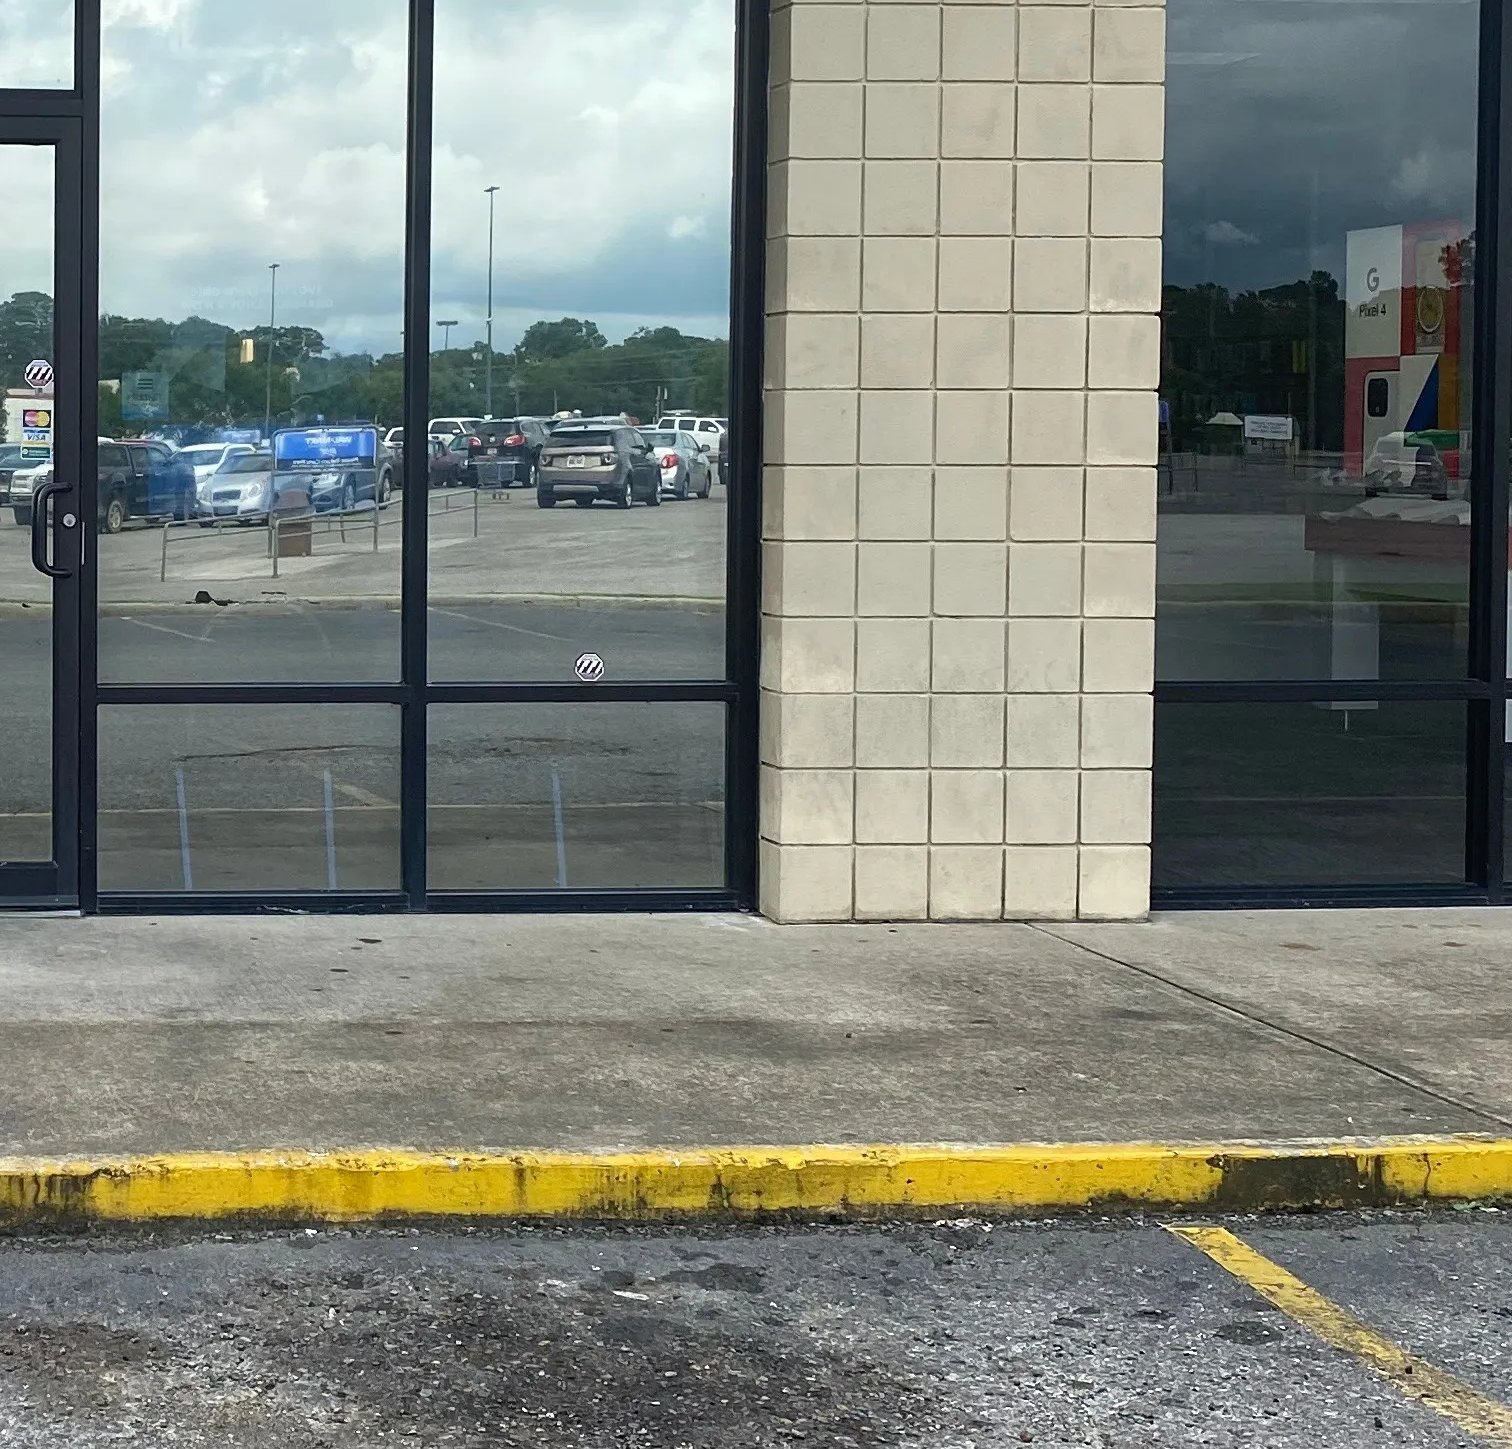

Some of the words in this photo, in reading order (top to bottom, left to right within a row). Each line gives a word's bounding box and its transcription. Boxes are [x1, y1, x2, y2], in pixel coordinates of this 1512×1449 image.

[1367, 267, 1380, 292] G
[1359, 303, 1379, 317] Pixel
[1380, 303, 1387, 316] 4
